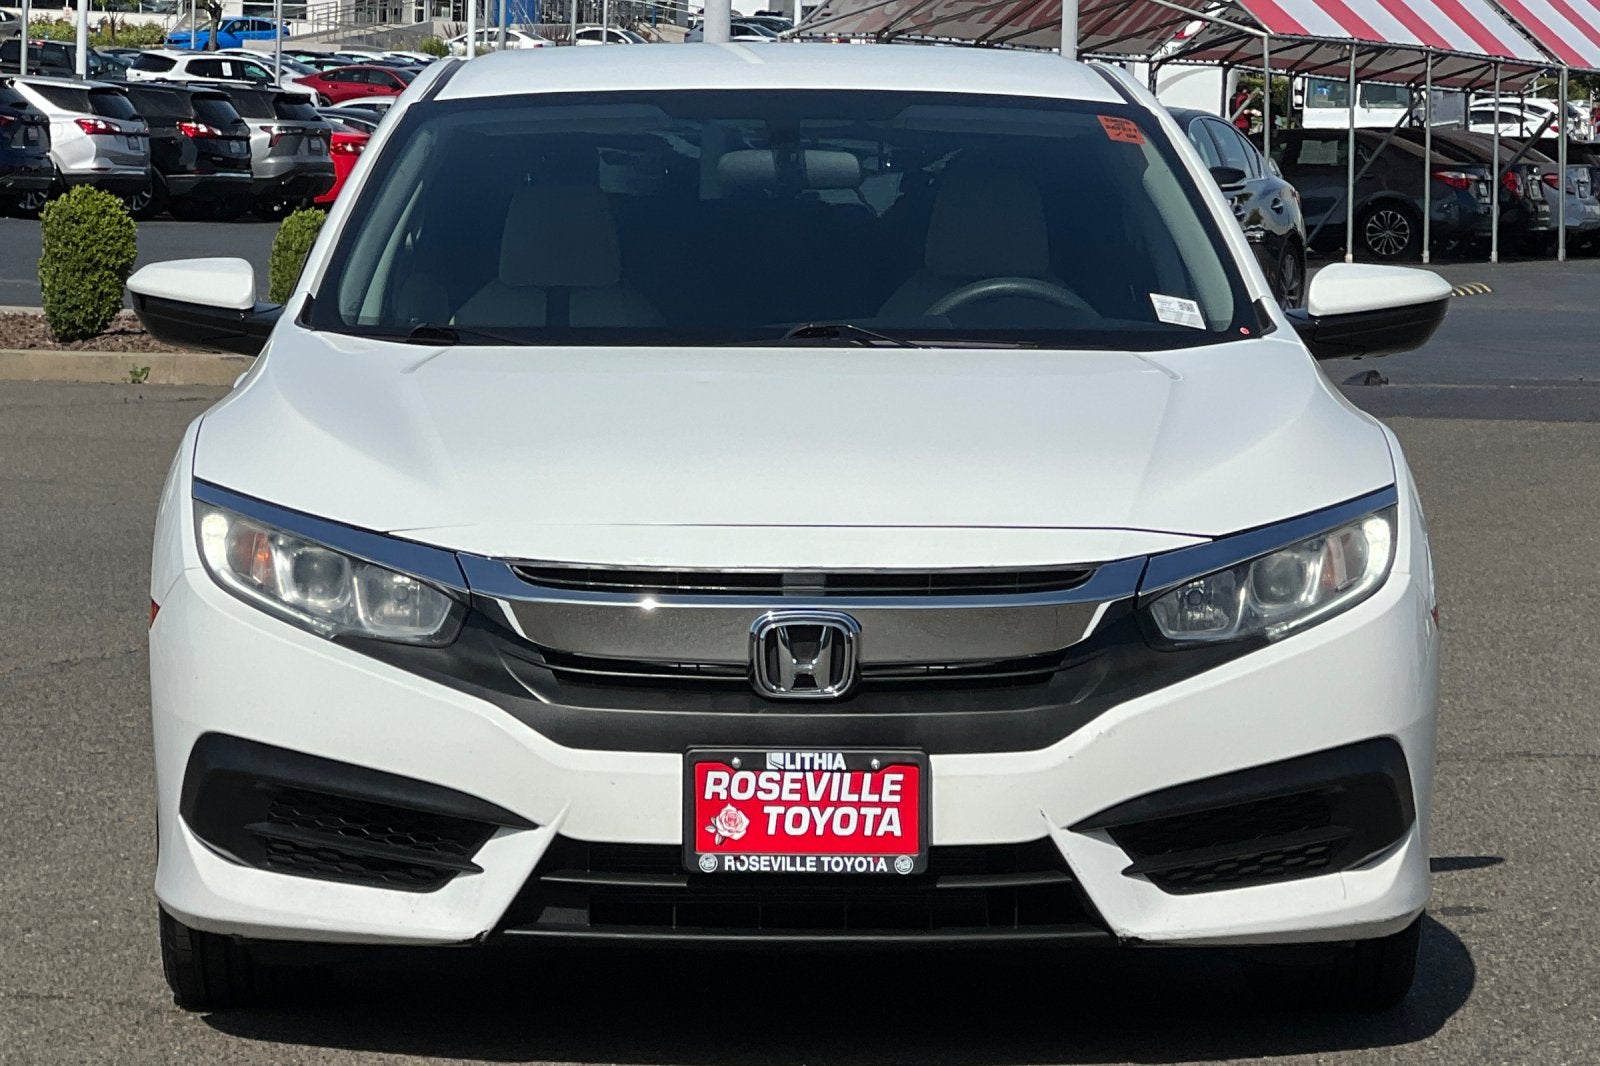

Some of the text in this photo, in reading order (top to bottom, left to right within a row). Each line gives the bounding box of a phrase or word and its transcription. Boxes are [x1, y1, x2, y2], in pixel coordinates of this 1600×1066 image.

[784, 752, 847, 770] LITHIA
[704, 771, 904, 802] ROSEVILLE
[763, 806, 902, 836] TOYOTA
[725, 855, 816, 872] ROSEVILLE
[821, 856, 888, 872] TOYOTA
